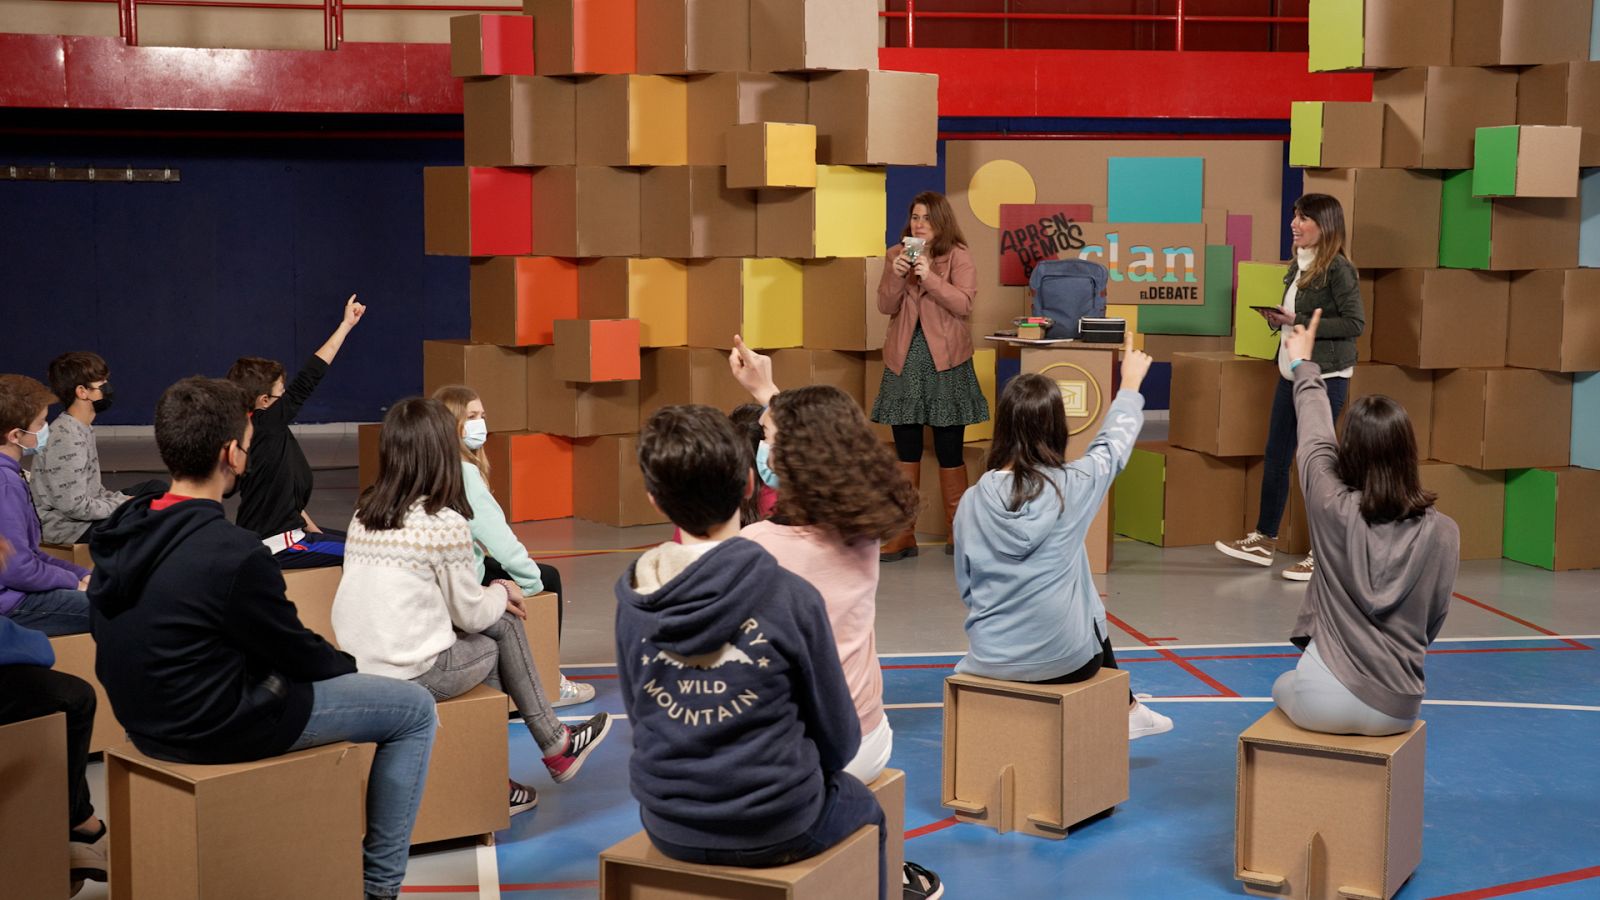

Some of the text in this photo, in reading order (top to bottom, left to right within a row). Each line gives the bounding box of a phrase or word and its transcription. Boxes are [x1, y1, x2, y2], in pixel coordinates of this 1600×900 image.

[1019, 224, 1086, 266] DEMOS
[1149, 286, 1198, 300] DEBATE
[676, 679, 728, 695] WILD
[643, 679, 760, 727] MOUNTAIN
